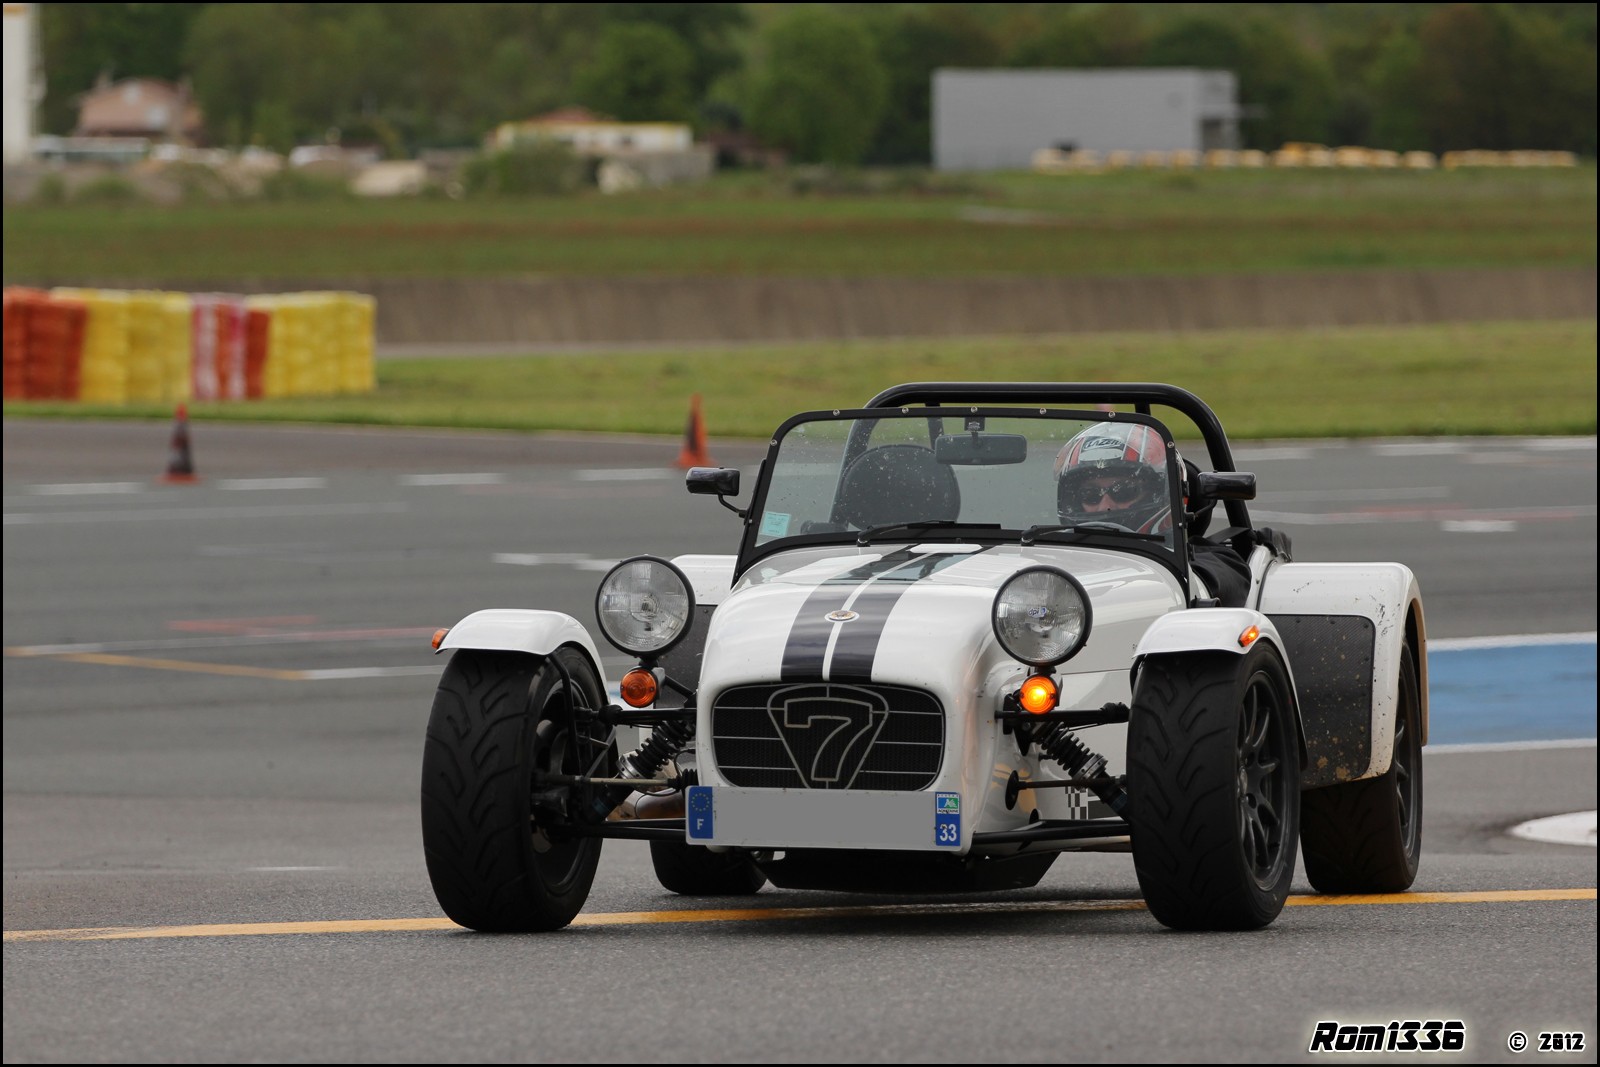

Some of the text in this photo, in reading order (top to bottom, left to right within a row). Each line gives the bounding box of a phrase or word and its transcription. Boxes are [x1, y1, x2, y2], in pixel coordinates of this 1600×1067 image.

[783, 696, 873, 782] 7
[697, 818, 705, 830] F
[939, 823, 957, 842] 33
